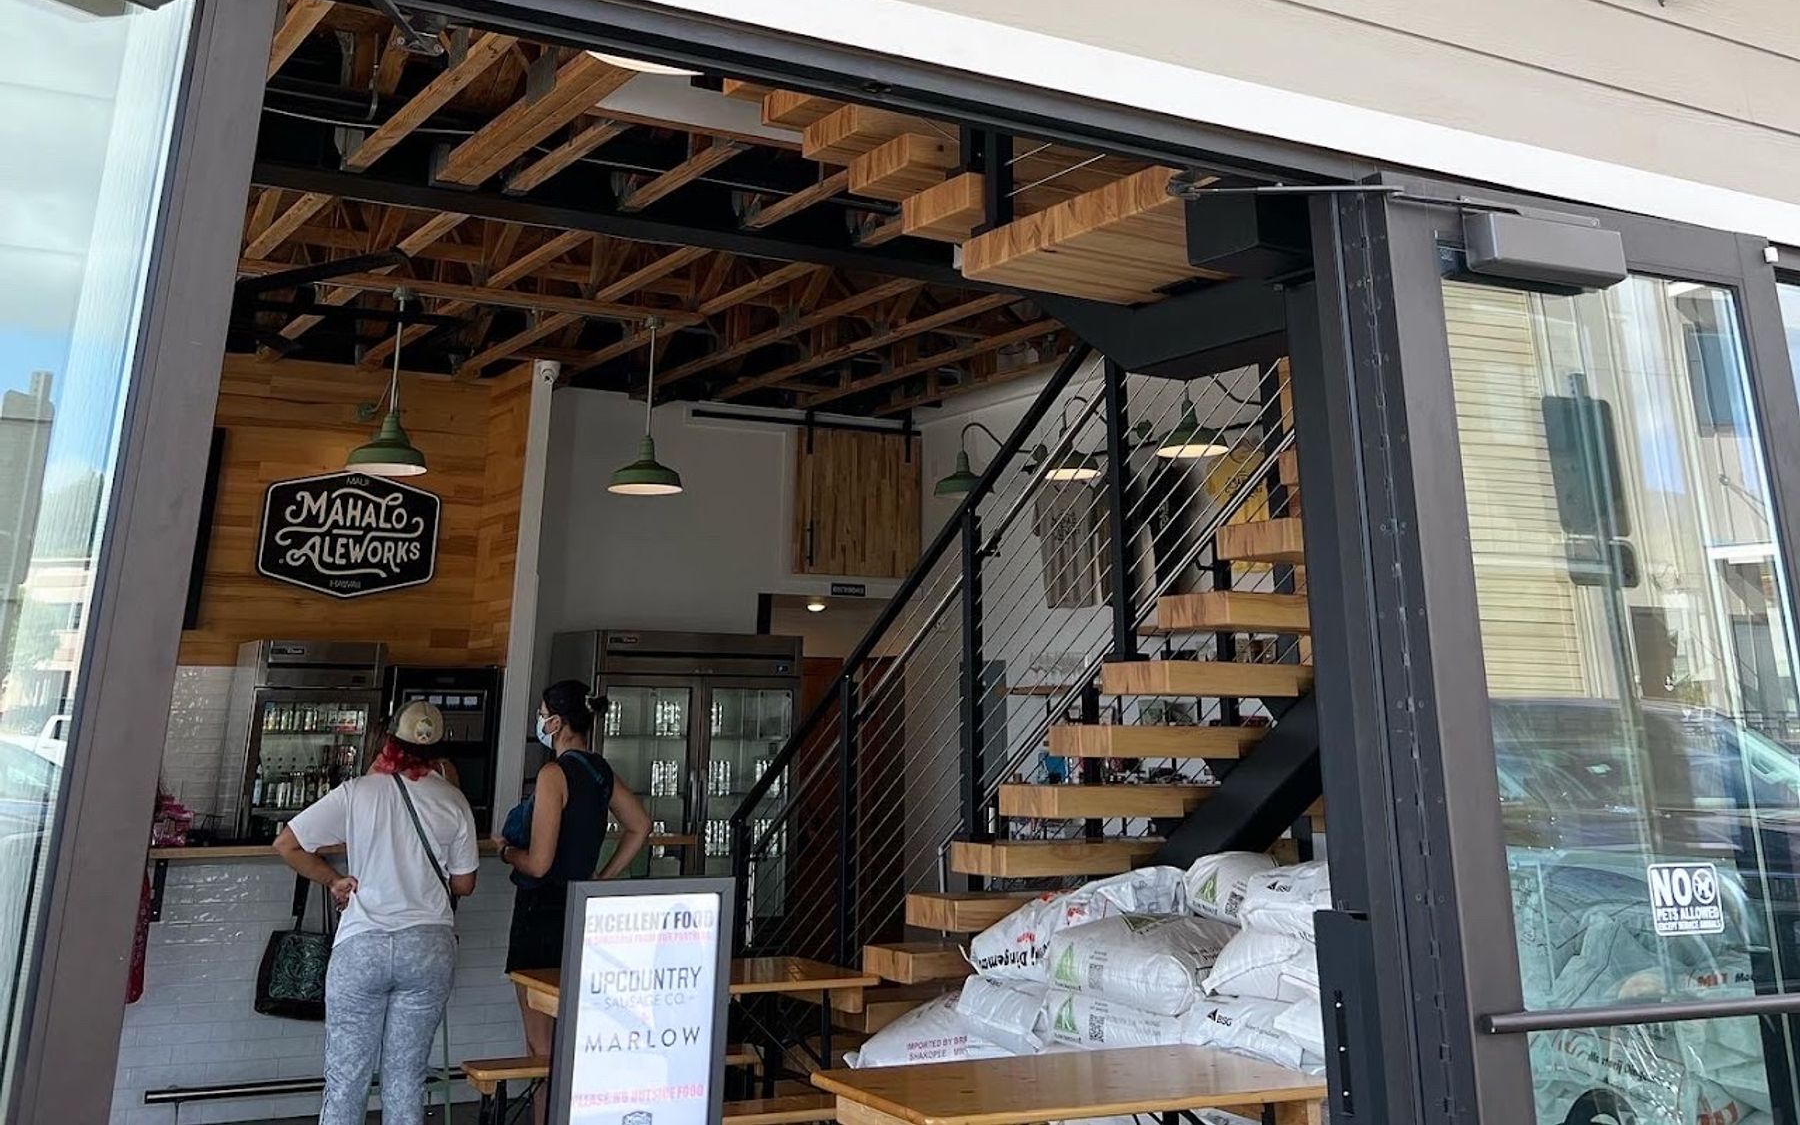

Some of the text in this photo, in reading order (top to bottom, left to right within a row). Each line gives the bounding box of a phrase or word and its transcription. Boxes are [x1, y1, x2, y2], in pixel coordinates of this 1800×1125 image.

[275, 488, 408, 543] MAHALO
[285, 531, 423, 578] ALEWORKS
[1651, 868, 1693, 906] NO
[586, 909, 714, 934] EXCELLENT FOOD
[1656, 905, 1720, 921] PETS ALLOWED
[590, 966, 702, 994] UPCOUNTRY
[1216, 1015, 1233, 1027] BSG
[584, 1026, 701, 1053] MARLOW
